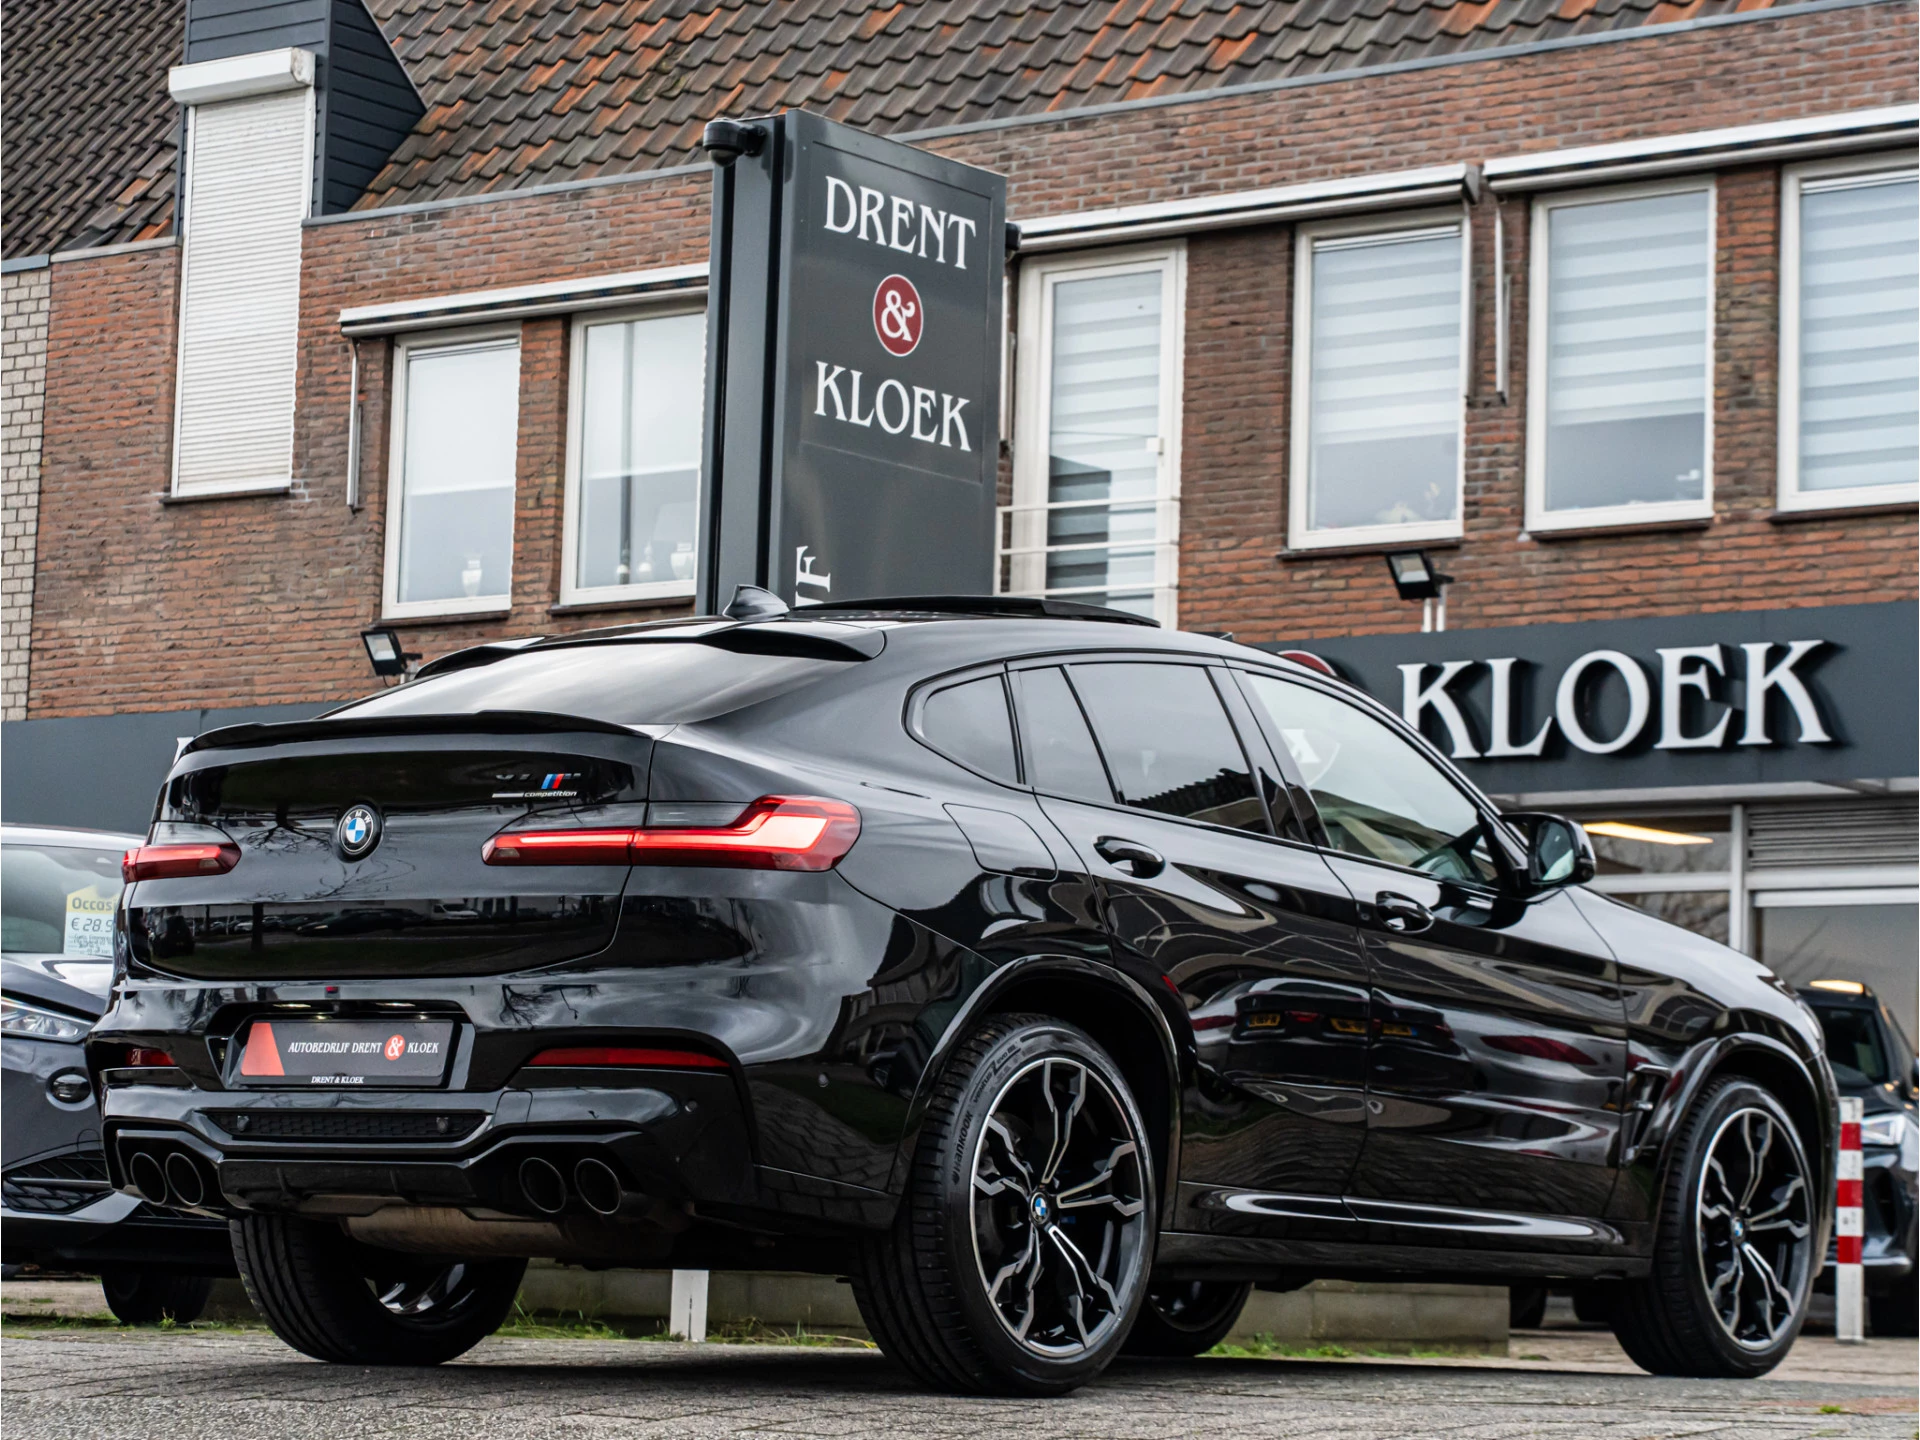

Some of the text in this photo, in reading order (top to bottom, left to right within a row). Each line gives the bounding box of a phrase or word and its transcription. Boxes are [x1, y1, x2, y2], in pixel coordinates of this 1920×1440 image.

[823, 176, 977, 270] DRENT
[880, 289, 916, 342] &
[814, 361, 971, 452] KLOEK
[1398, 640, 1833, 759] KLOEK
[288, 1037, 439, 1057] AUTOBEDRIJF DRENT & KLOEK
[311, 1076, 334, 1084] DRENT
[340, 1076, 364, 1084] KLOEK
